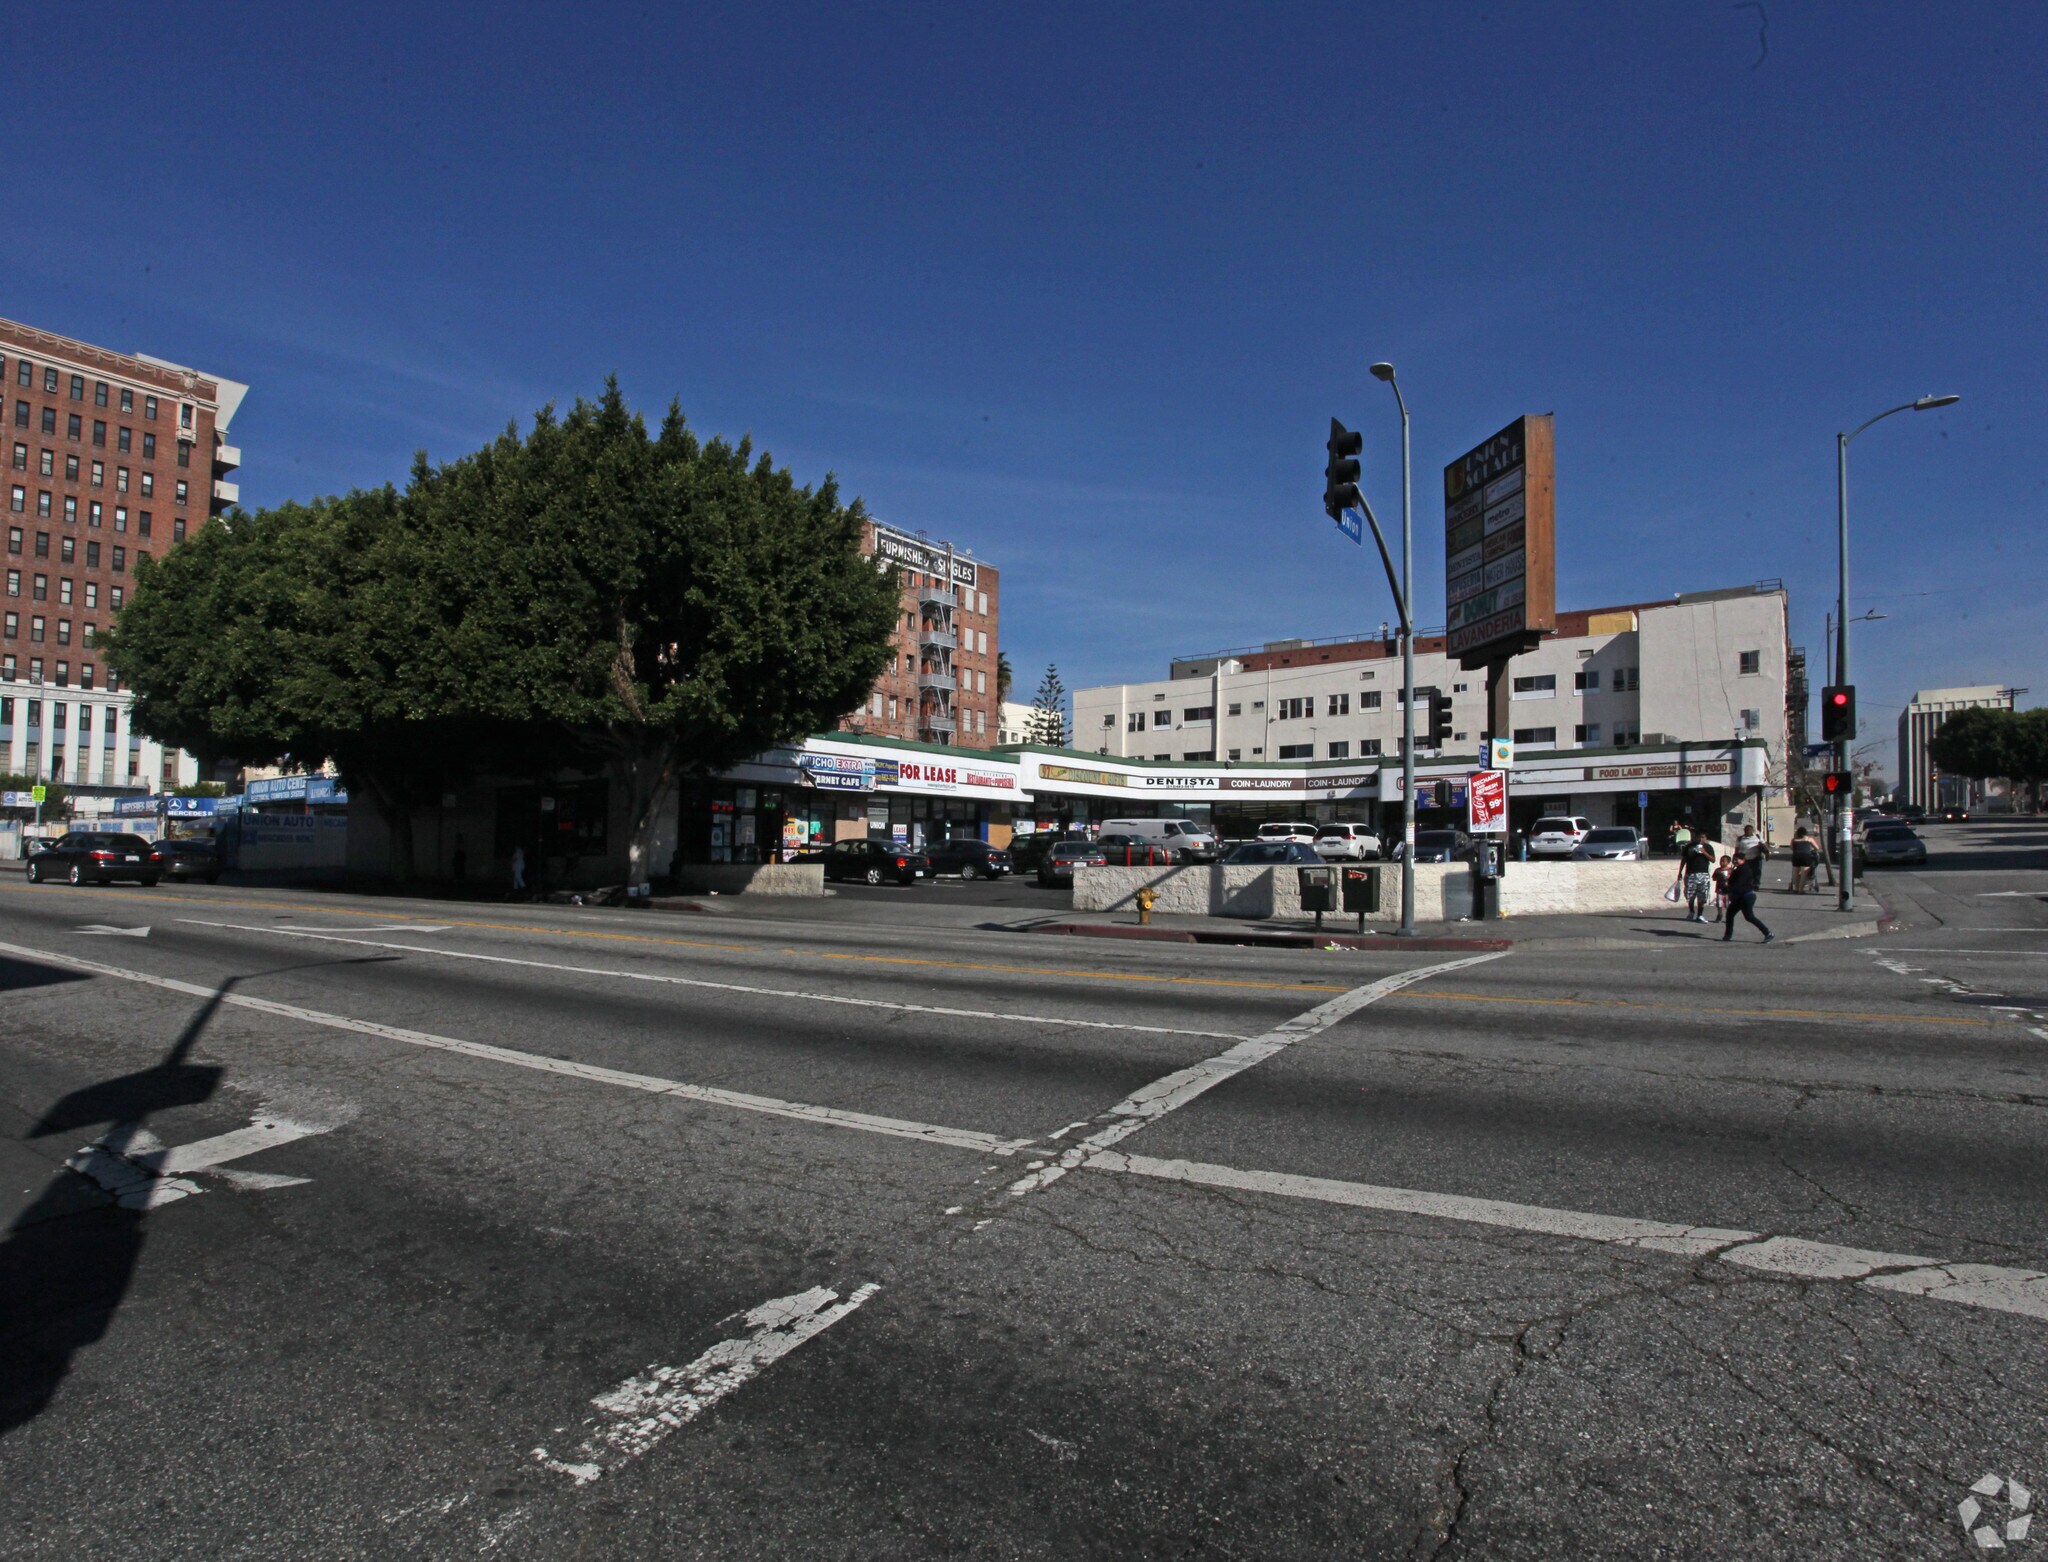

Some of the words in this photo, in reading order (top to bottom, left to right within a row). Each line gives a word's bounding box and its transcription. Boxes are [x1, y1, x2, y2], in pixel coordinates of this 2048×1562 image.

[1466, 435, 1509, 472] UNION
[1466, 443, 1521, 489] SQUARE
[1341, 511, 1359, 537] Union
[937, 557, 973, 581] SIGLES
[1451, 610, 1522, 651] LAVANDERIA
[801, 754, 833, 768] MUCHO
[836, 759, 863, 771] EXTRA
[1705, 763, 1727, 773] FOOD
[900, 763, 920, 780] FOR
[924, 766, 957, 783] LEASE
[1473, 772, 1501, 787] RECHARGE
[1600, 768, 1619, 778] FOOD
[1621, 767, 1643, 777] LAND
[251, 781, 269, 794] UNION
[270, 779, 286, 791] AUTO
[841, 776, 860, 787] CAFE
[1146, 778, 1215, 786] DENTISTA
[1231, 780, 1292, 788] COIN-LAUNDRY
[1308, 776, 1373, 788] COIN-LAUNDRY
[1476, 782, 1498, 795] REFRESH
[242, 814, 281, 826] UNION
[284, 816, 314, 827] AUTO
[870, 821, 886, 829] UNION
